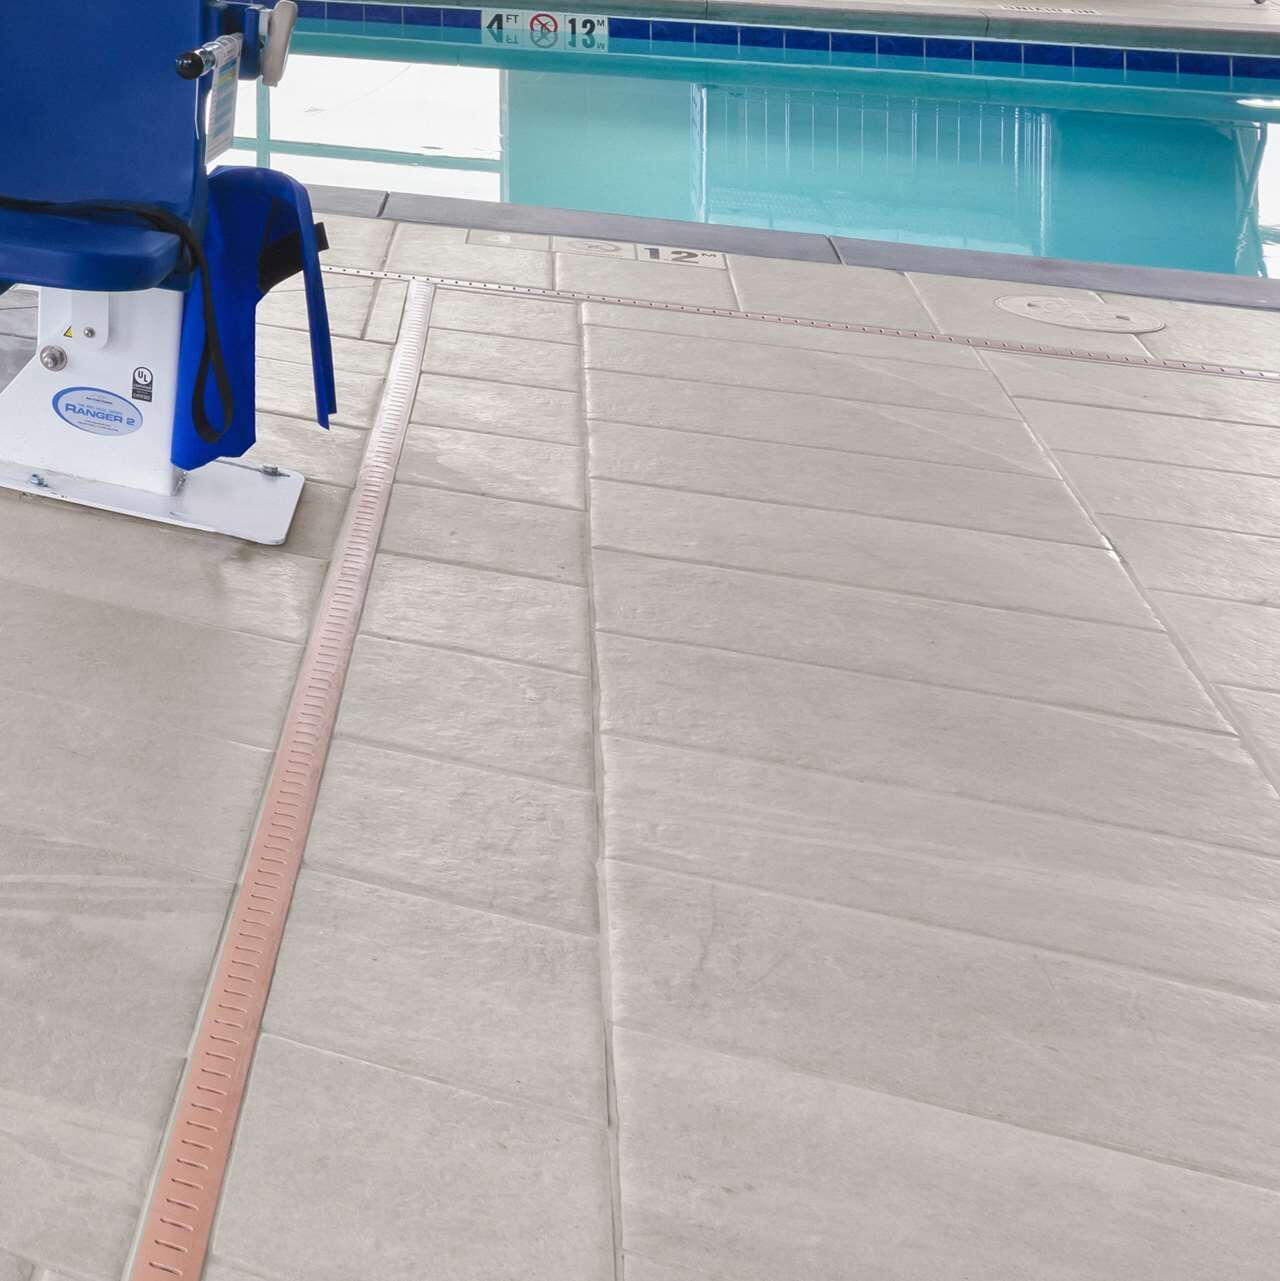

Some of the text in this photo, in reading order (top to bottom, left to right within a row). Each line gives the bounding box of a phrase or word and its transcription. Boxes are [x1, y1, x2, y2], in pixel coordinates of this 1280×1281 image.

[506, 14, 519, 24] FT
[64, 403, 123, 424] RANGER
[126, 417, 136, 426] 2
